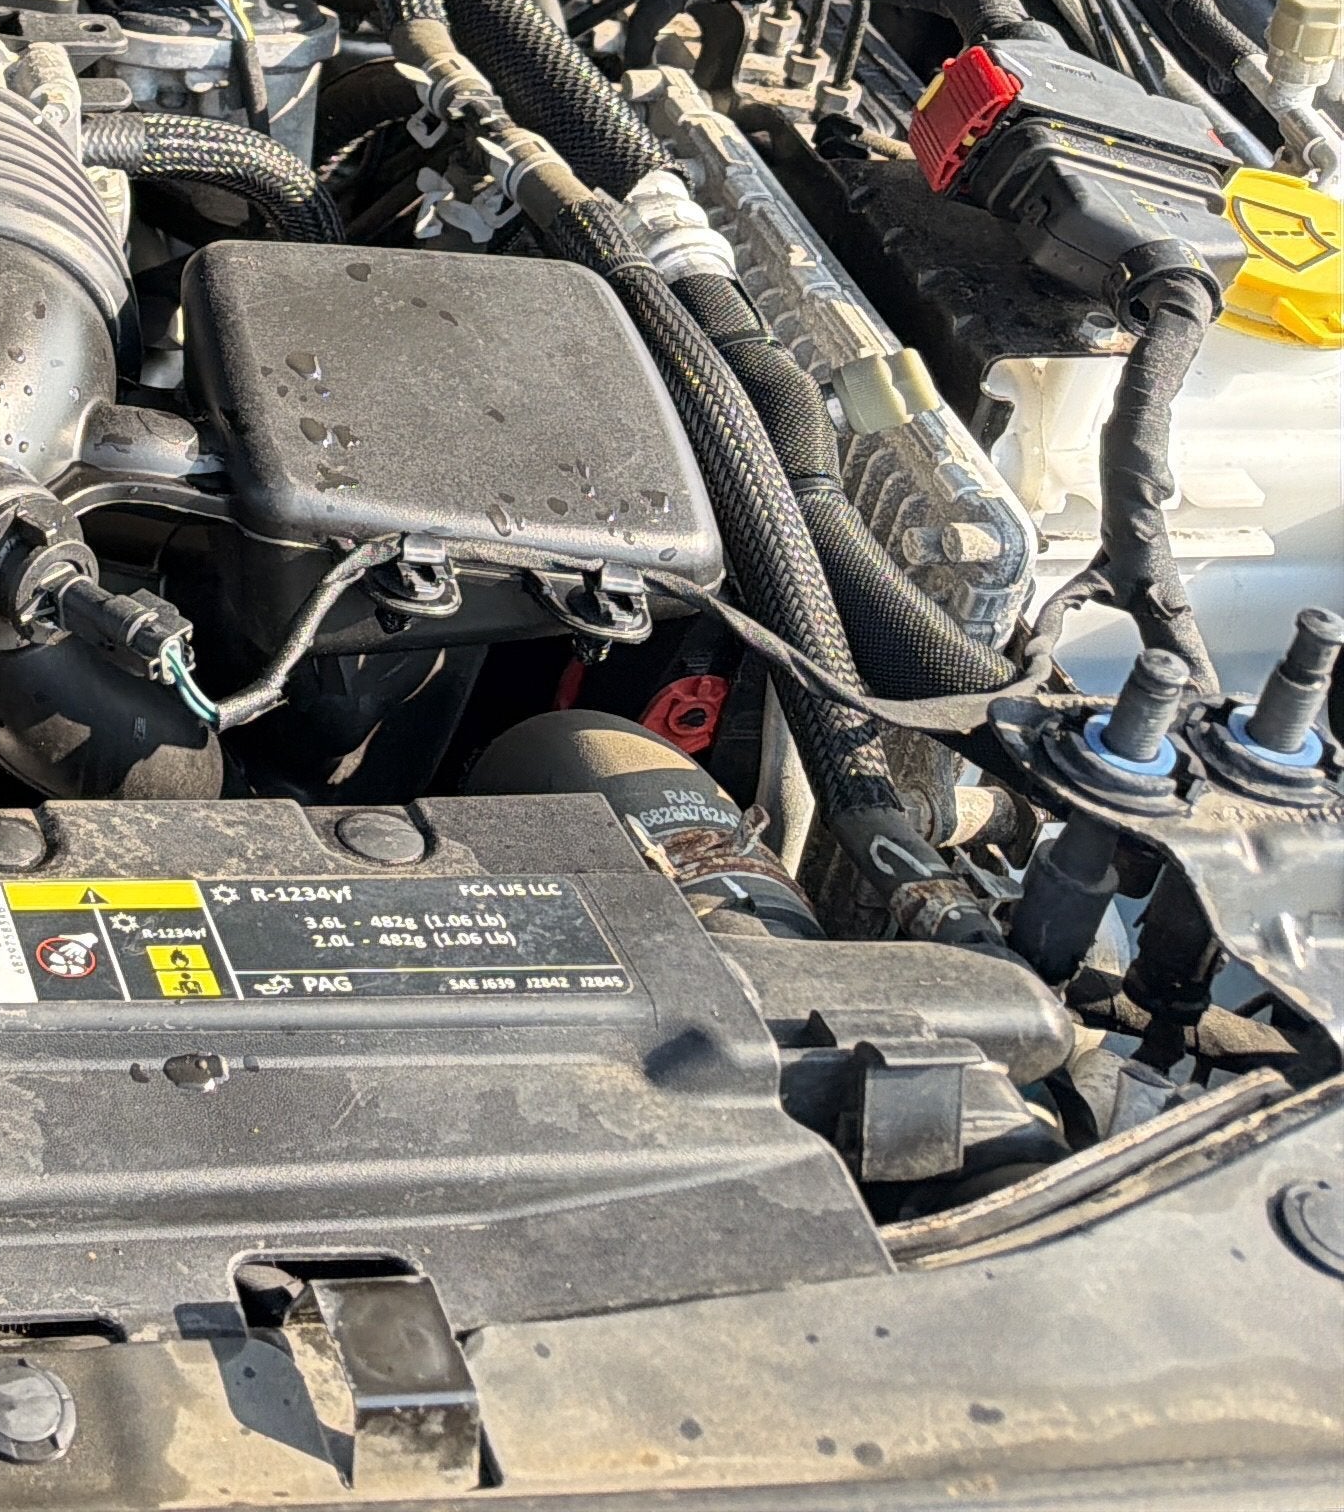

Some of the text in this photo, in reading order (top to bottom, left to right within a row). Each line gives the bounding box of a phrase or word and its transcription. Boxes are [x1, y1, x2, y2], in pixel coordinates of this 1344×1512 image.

[662, 790, 706, 805] RAD
[252, 887, 353, 904] R-1234yf
[460, 883, 562, 897] FCA US LLC
[304, 916, 346, 930] 3.6L
[370, 915, 418, 931] 482g
[425, 915, 473, 930] (1.06
[476, 913, 507, 929] Lb)
[142, 927, 207, 940] R-1234yf
[313, 934, 354, 948] 2.0L
[378, 934, 427, 949] 482g
[433, 933, 481, 947] (1.06
[485, 931, 517, 947] Lb)
[302, 977, 353, 993] PAG
[448, 979, 479, 991] SAE
[526, 977, 570, 989] J2842
[580, 976, 624, 988] J2845
